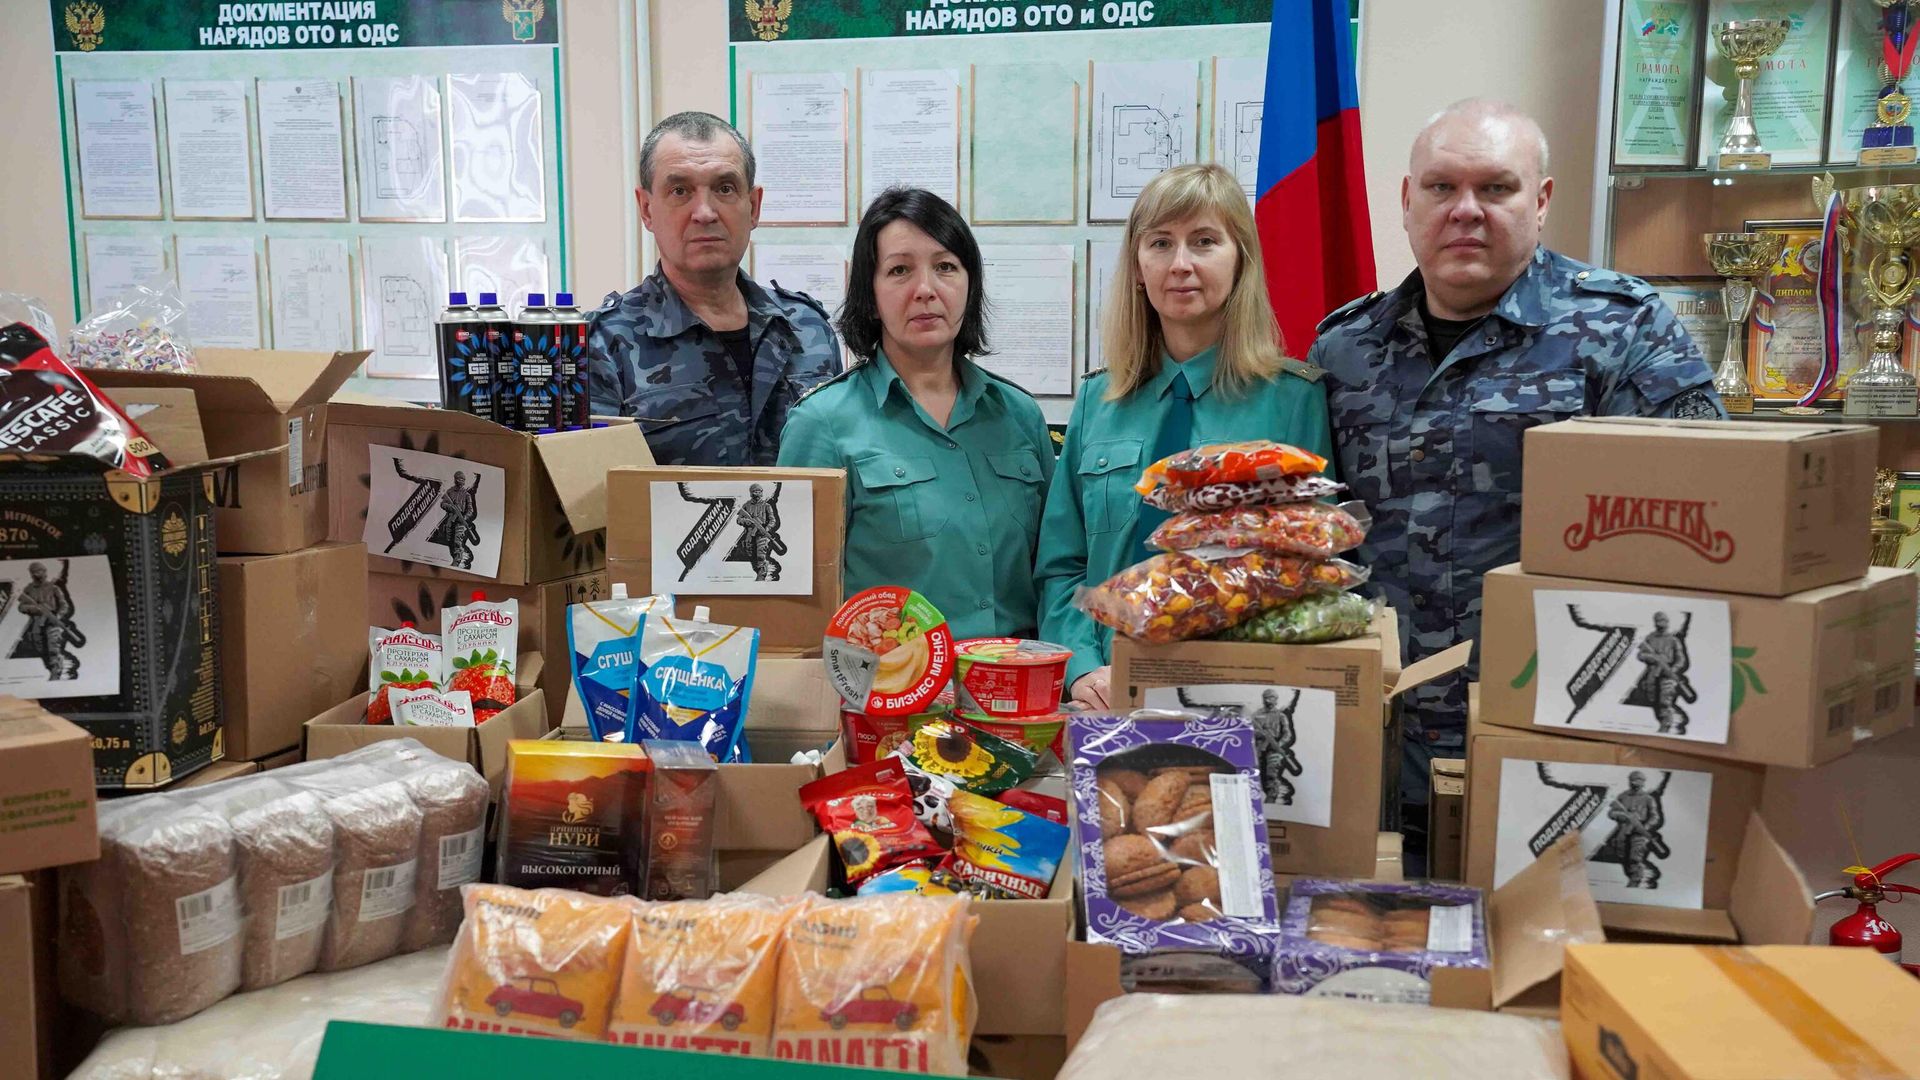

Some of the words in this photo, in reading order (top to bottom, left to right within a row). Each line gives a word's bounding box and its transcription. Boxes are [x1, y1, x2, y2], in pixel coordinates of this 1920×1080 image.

[218, 1, 376, 25] ДОКУМЕНТАЦИЯ
[906, 7, 1017, 32] НАРЯДОВ
[1023, 4, 1074, 25] ОТО
[1080, 8, 1095, 24] и
[1102, 1, 1154, 26] ОДС
[199, 26, 291, 48] НАРЯДОВ
[295, 25, 335, 43] ОТО
[340, 29, 353, 43] и
[357, 23, 400, 46] ОДС
[1636, 62, 1680, 75] ГРАМОТА
[1759, 58, 1807, 72] МОТА
[1775, 288, 1812, 297] ДИПЛОМ
[17, 406, 91, 452] LASSIC
[391, 481, 432, 531] ПОДДЕРЖИМ
[412, 487, 437, 521] НАШИХ!
[680, 499, 724, 558] ПОДДЕРЖИМ
[703, 505, 730, 544] НАШИХ!
[830, 649, 864, 701] SmartFresh
[886, 677, 935, 709] БИЗНЕС
[929, 631, 944, 677] МЕНЮ
[1570, 627, 1622, 696] ПОДДЕРЖИМ
[654, 666, 724, 692] СГУЩЕНКА
[1533, 786, 1592, 852] ПОДДЕРЖИМ
[549, 832, 600, 848] НУРИ
[521, 864, 621, 876] ВЫСОКОГОРНЫЙ
